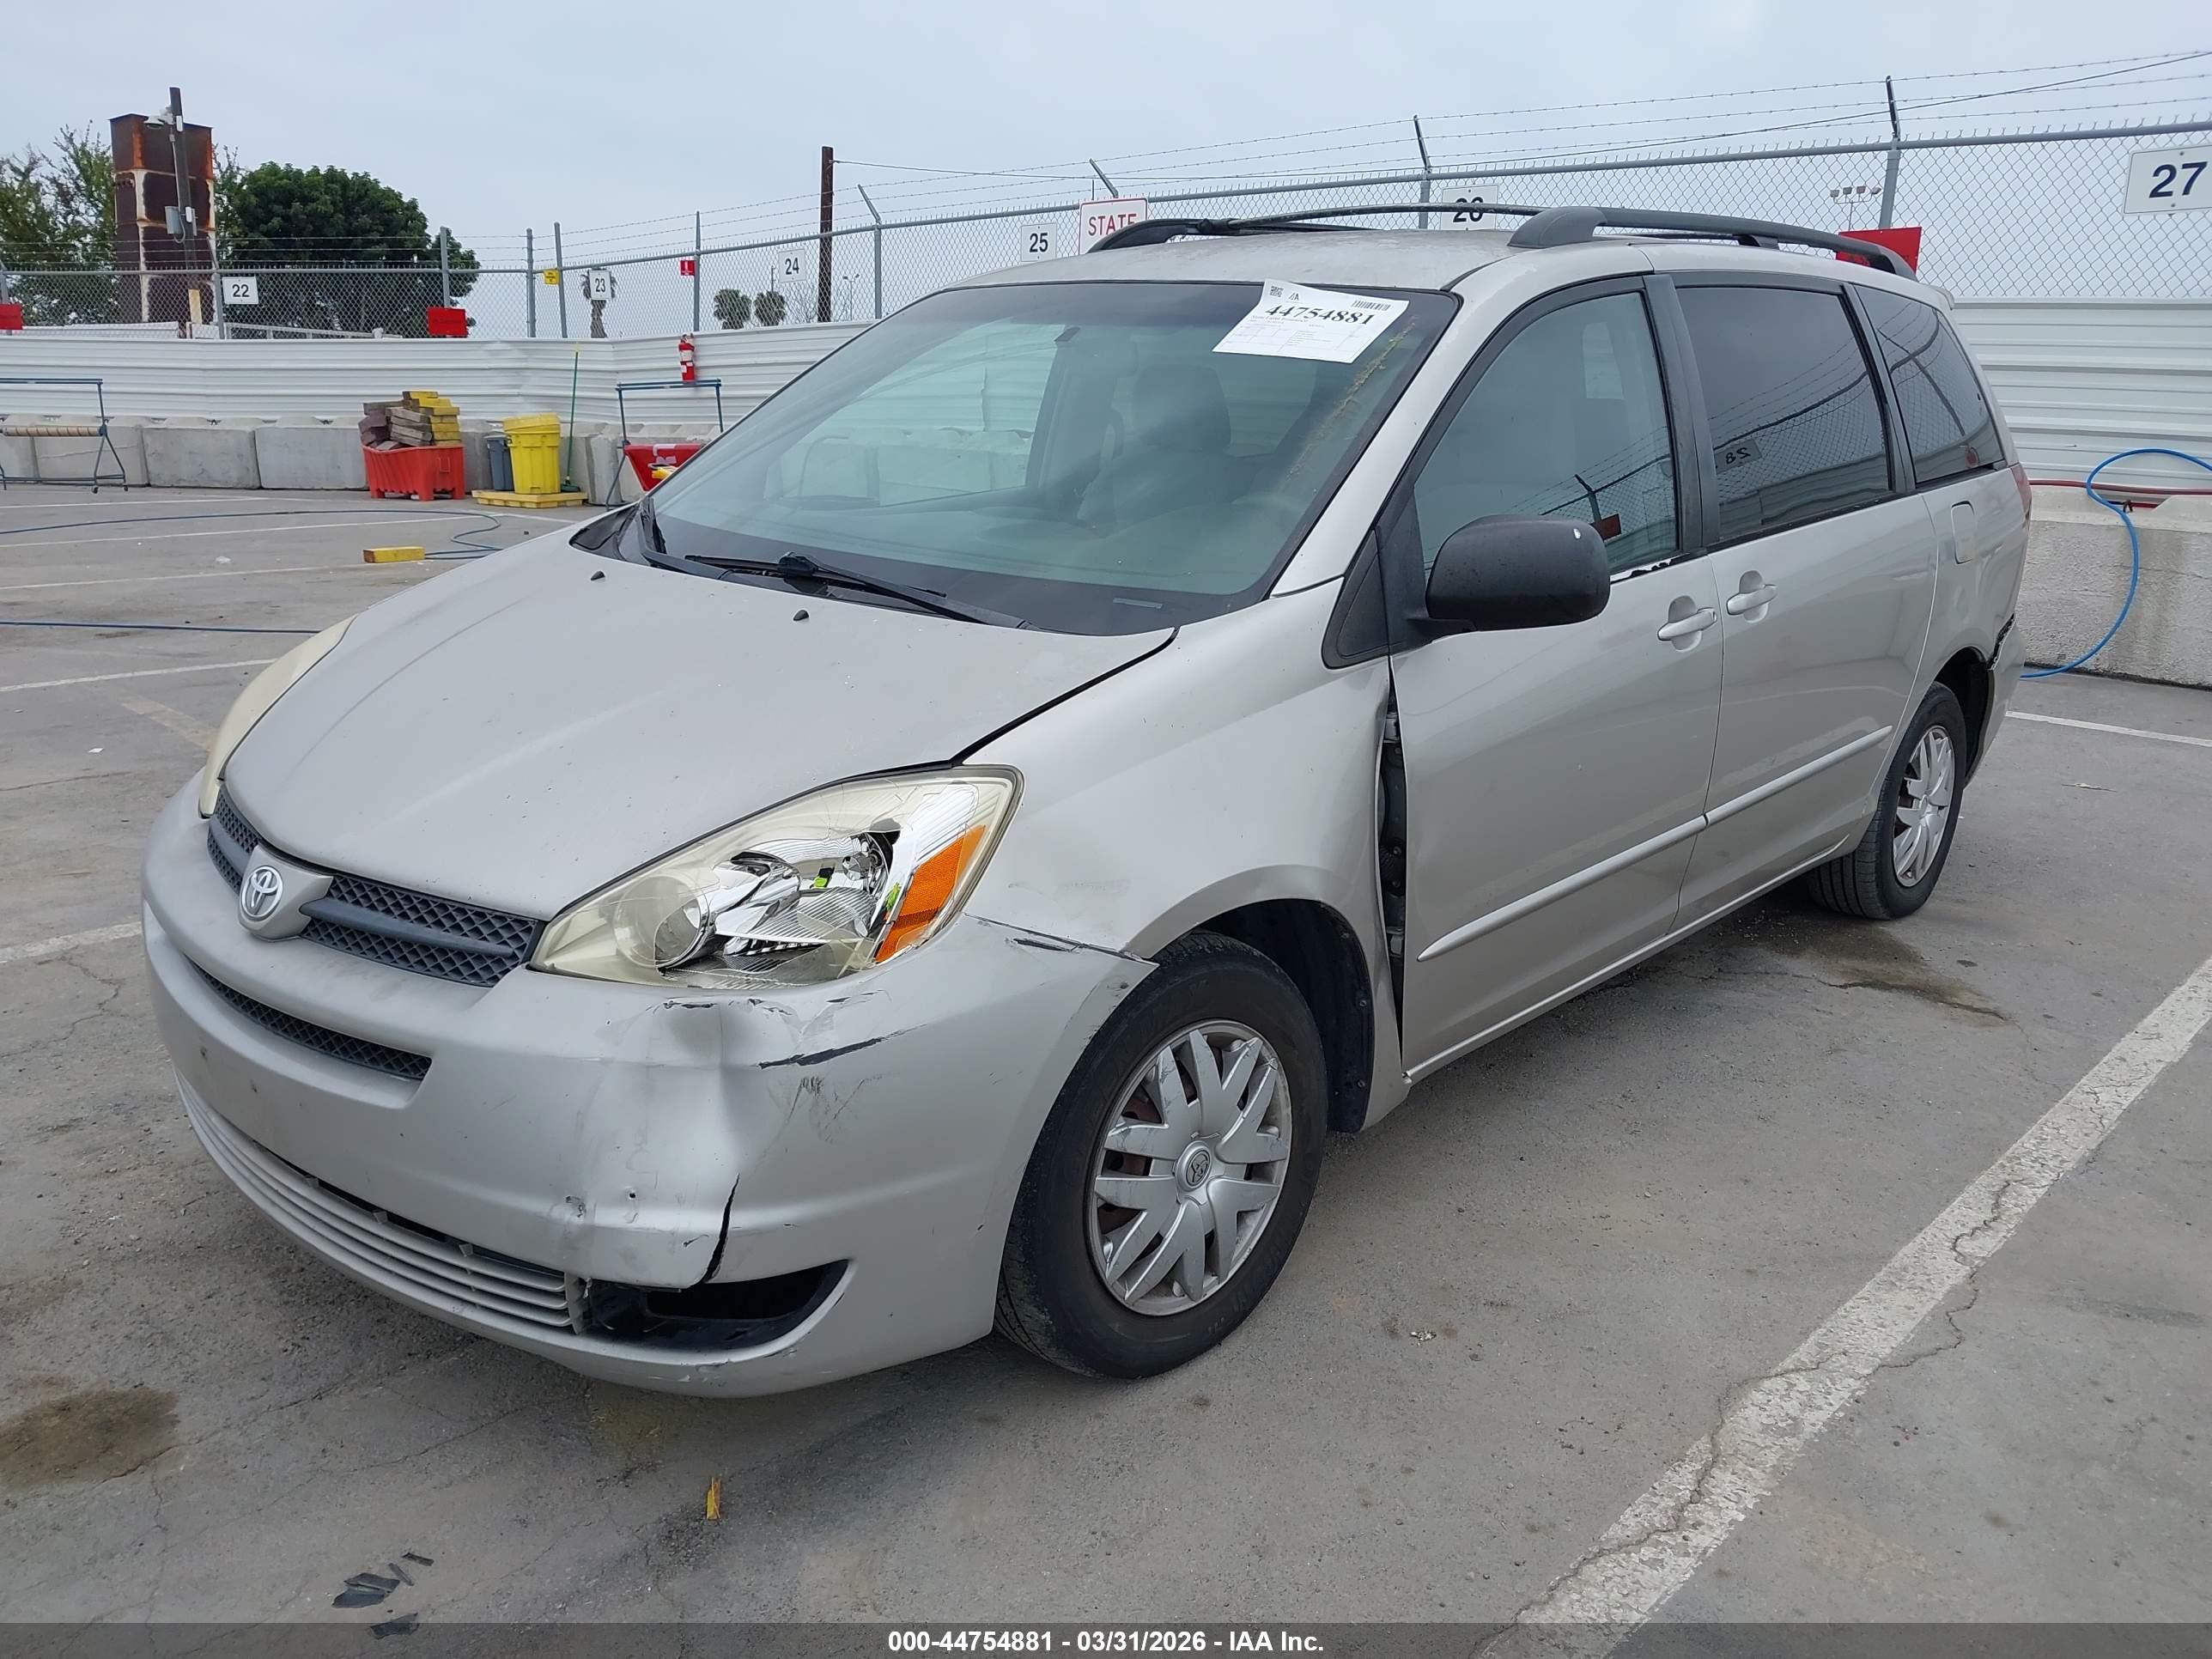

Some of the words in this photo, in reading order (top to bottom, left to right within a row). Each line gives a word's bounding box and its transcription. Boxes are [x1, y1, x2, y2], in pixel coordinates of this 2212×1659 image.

[2148, 161, 2209, 198] 27
[1029, 232, 1048, 252] 25
[785, 257, 799, 275] 24
[232, 283, 250, 297] 22
[594, 277, 606, 293] 23
[1265, 305, 1375, 325] 44754881
